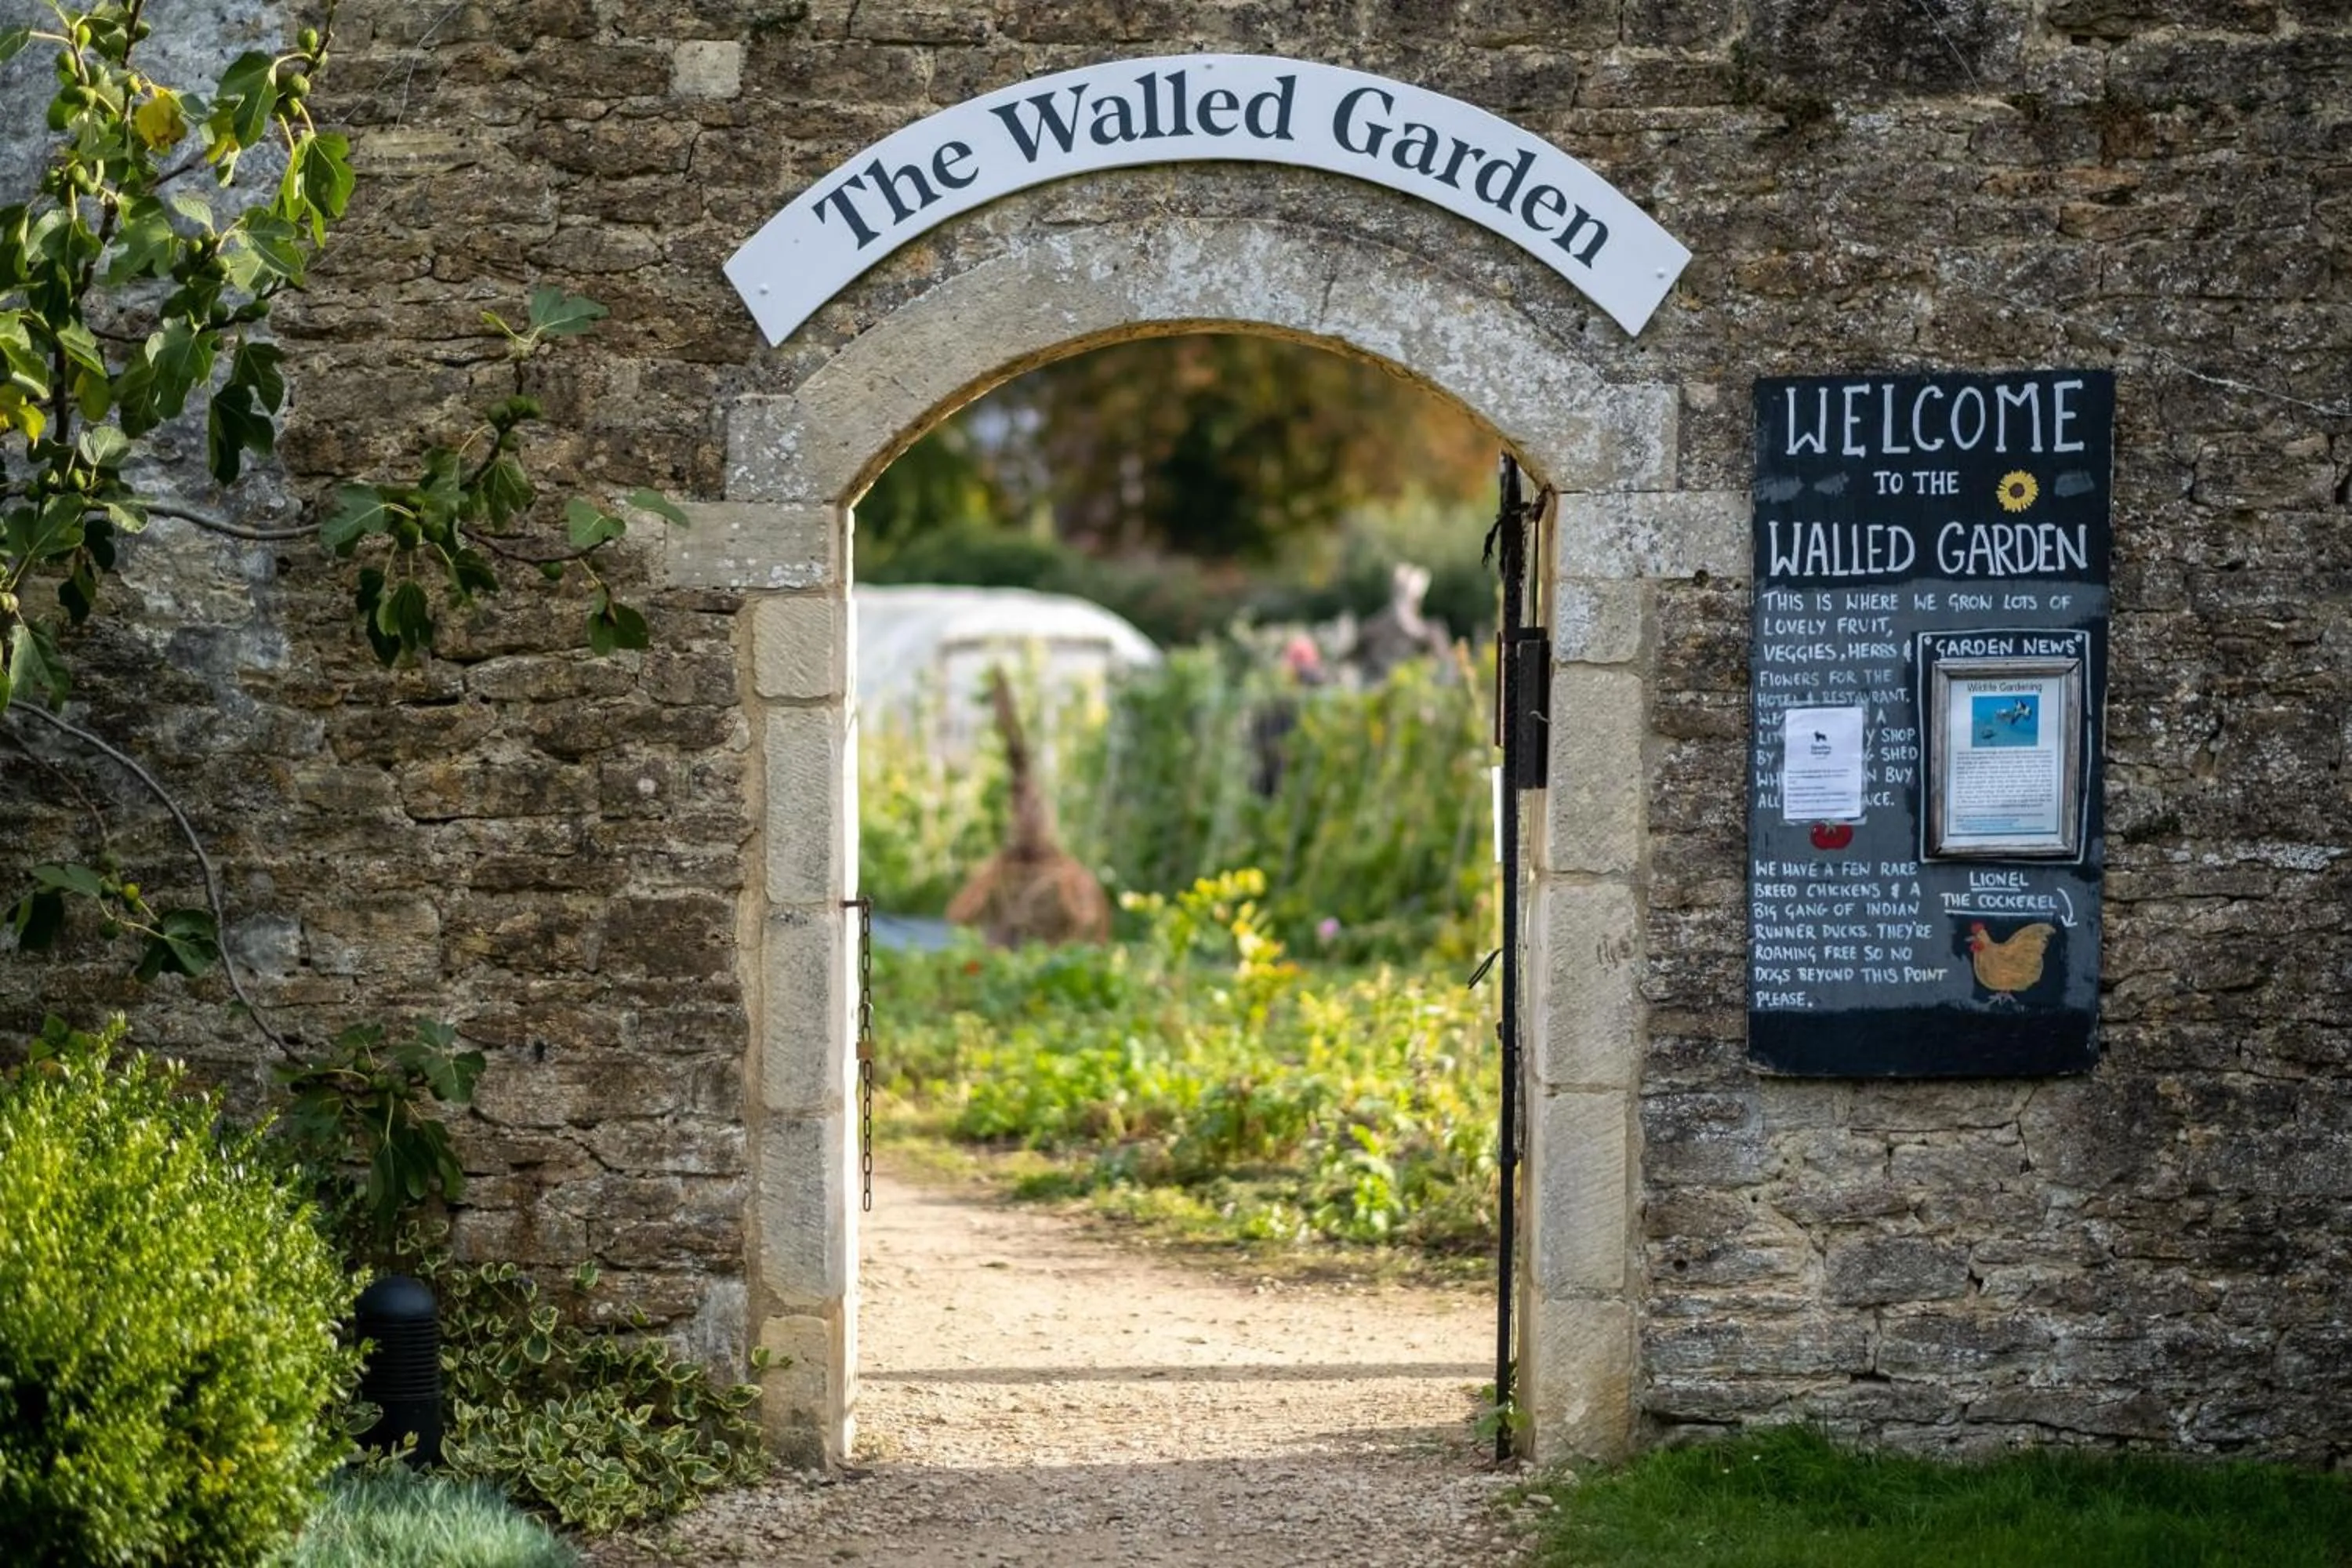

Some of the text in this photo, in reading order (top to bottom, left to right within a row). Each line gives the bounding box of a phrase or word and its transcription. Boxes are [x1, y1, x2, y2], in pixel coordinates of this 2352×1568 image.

[811, 71, 1610, 270] The Walled Garden
[1785, 379, 2085, 457] WELCOME
[1874, 471, 1959, 495] TO THE
[1769, 521, 2088, 576] WALLED GARDEN
[1762, 590, 1804, 612] THIS
[1817, 593, 1832, 612] IS
[1846, 593, 1899, 611] WHERE
[1914, 593, 1937, 610] WE
[2003, 593, 2038, 610] LOTS
[2049, 595, 2073, 610] OF
[1764, 617, 1894, 637] LOVELY FRUIT,
[1848, 643, 1897, 660] HERBS
[1903, 639, 1912, 662] &
[1936, 637, 2076, 657] GARDEN NEWS
[1829, 670, 1857, 686] FOR
[1864, 669, 1893, 684] THE
[1999, 681, 2042, 693] Gardening
[1757, 692, 1800, 707] HOTEL
[1876, 708, 1886, 724] A
[1882, 728, 1915, 742] SHOP
[1756, 750, 1775, 767] BY
[1881, 746, 1918, 761] SHED
[1886, 766, 1913, 783] BUY
[1758, 793, 1780, 808] ALL
[1755, 860, 1777, 877] WE
[1782, 862, 1817, 877] HAVE
[1824, 863, 1834, 877] A
[1881, 862, 1918, 877] RARE
[1969, 871, 2030, 887] LIONEL
[1754, 883, 1797, 898] BREED
[1806, 883, 1881, 898] CHICKENS
[1910, 882, 1921, 897] A
[1940, 893, 2058, 909] THE COCKEREL
[1753, 902, 1920, 921] BIG GANG OF INDIAN
[1755, 920, 1933, 941] RUNNER DUCKS. THEY'RE
[1755, 944, 1913, 964] ROAMING FREE SO NO
[1754, 966, 1948, 985] DOGS BEYOND THIS POINT
[1756, 990, 1813, 1008] PLEASE.
